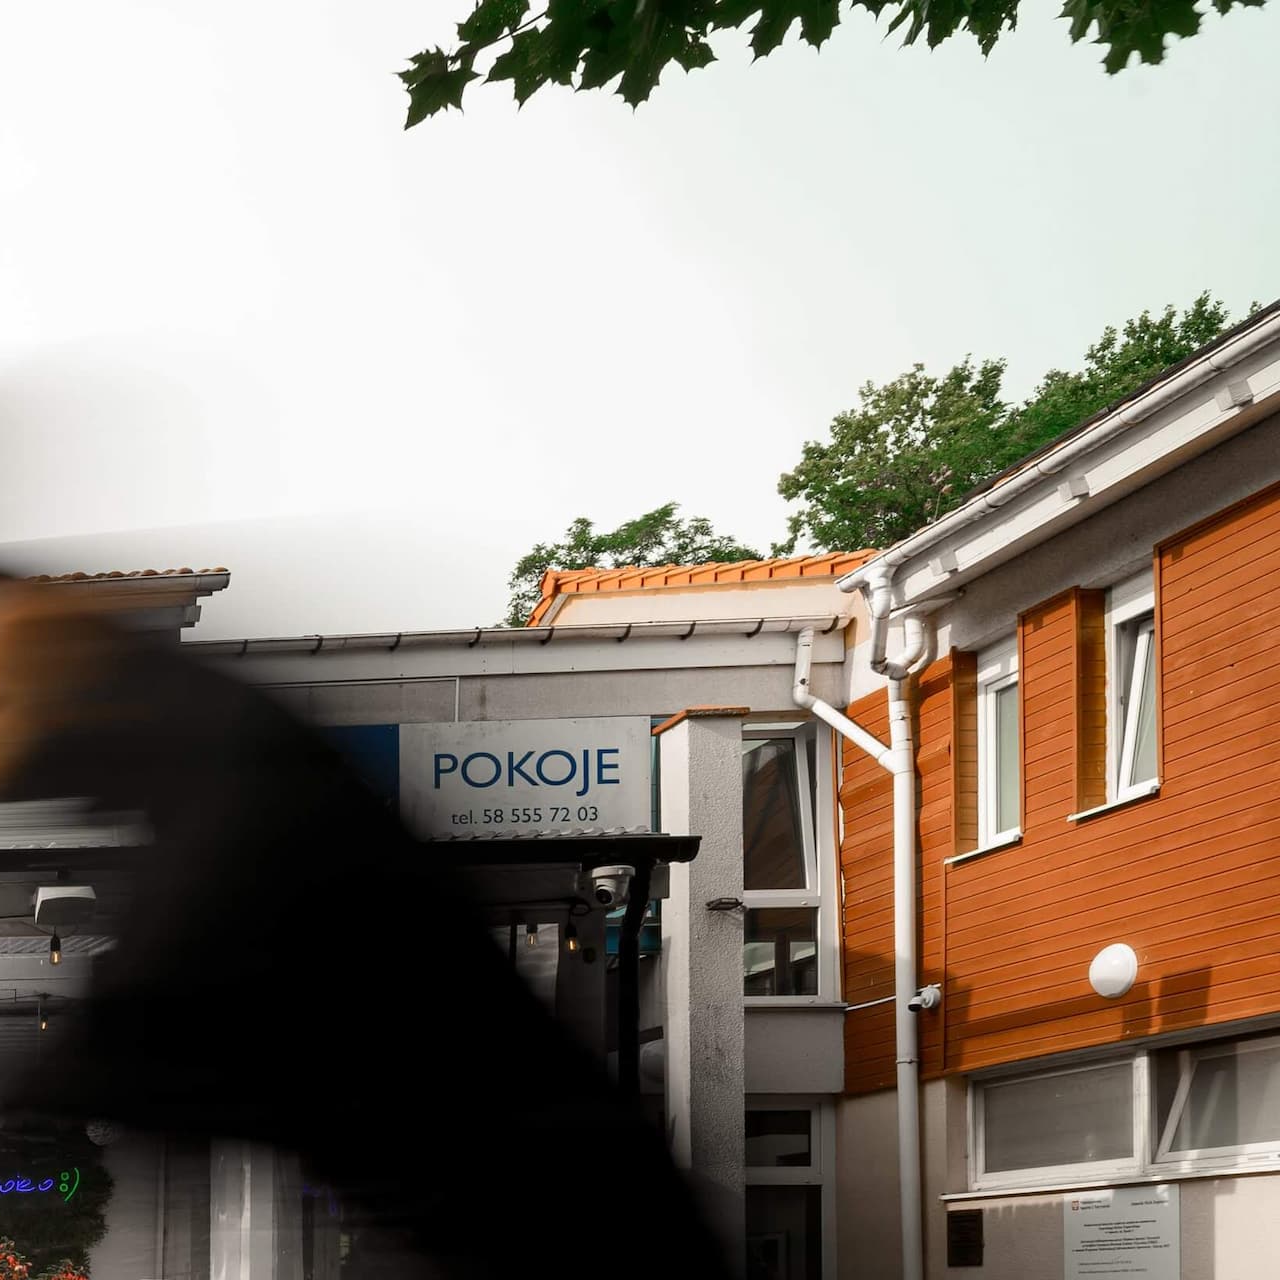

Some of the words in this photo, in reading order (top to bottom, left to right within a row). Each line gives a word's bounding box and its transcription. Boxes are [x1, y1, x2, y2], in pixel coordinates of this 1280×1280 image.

[433, 748, 620, 797] POKOJE
[452, 810, 478, 825] tel.
[483, 809, 504, 824] 58
[511, 808, 542, 823] 555
[550, 808, 571, 822] 72
[577, 807, 598, 821] 03
